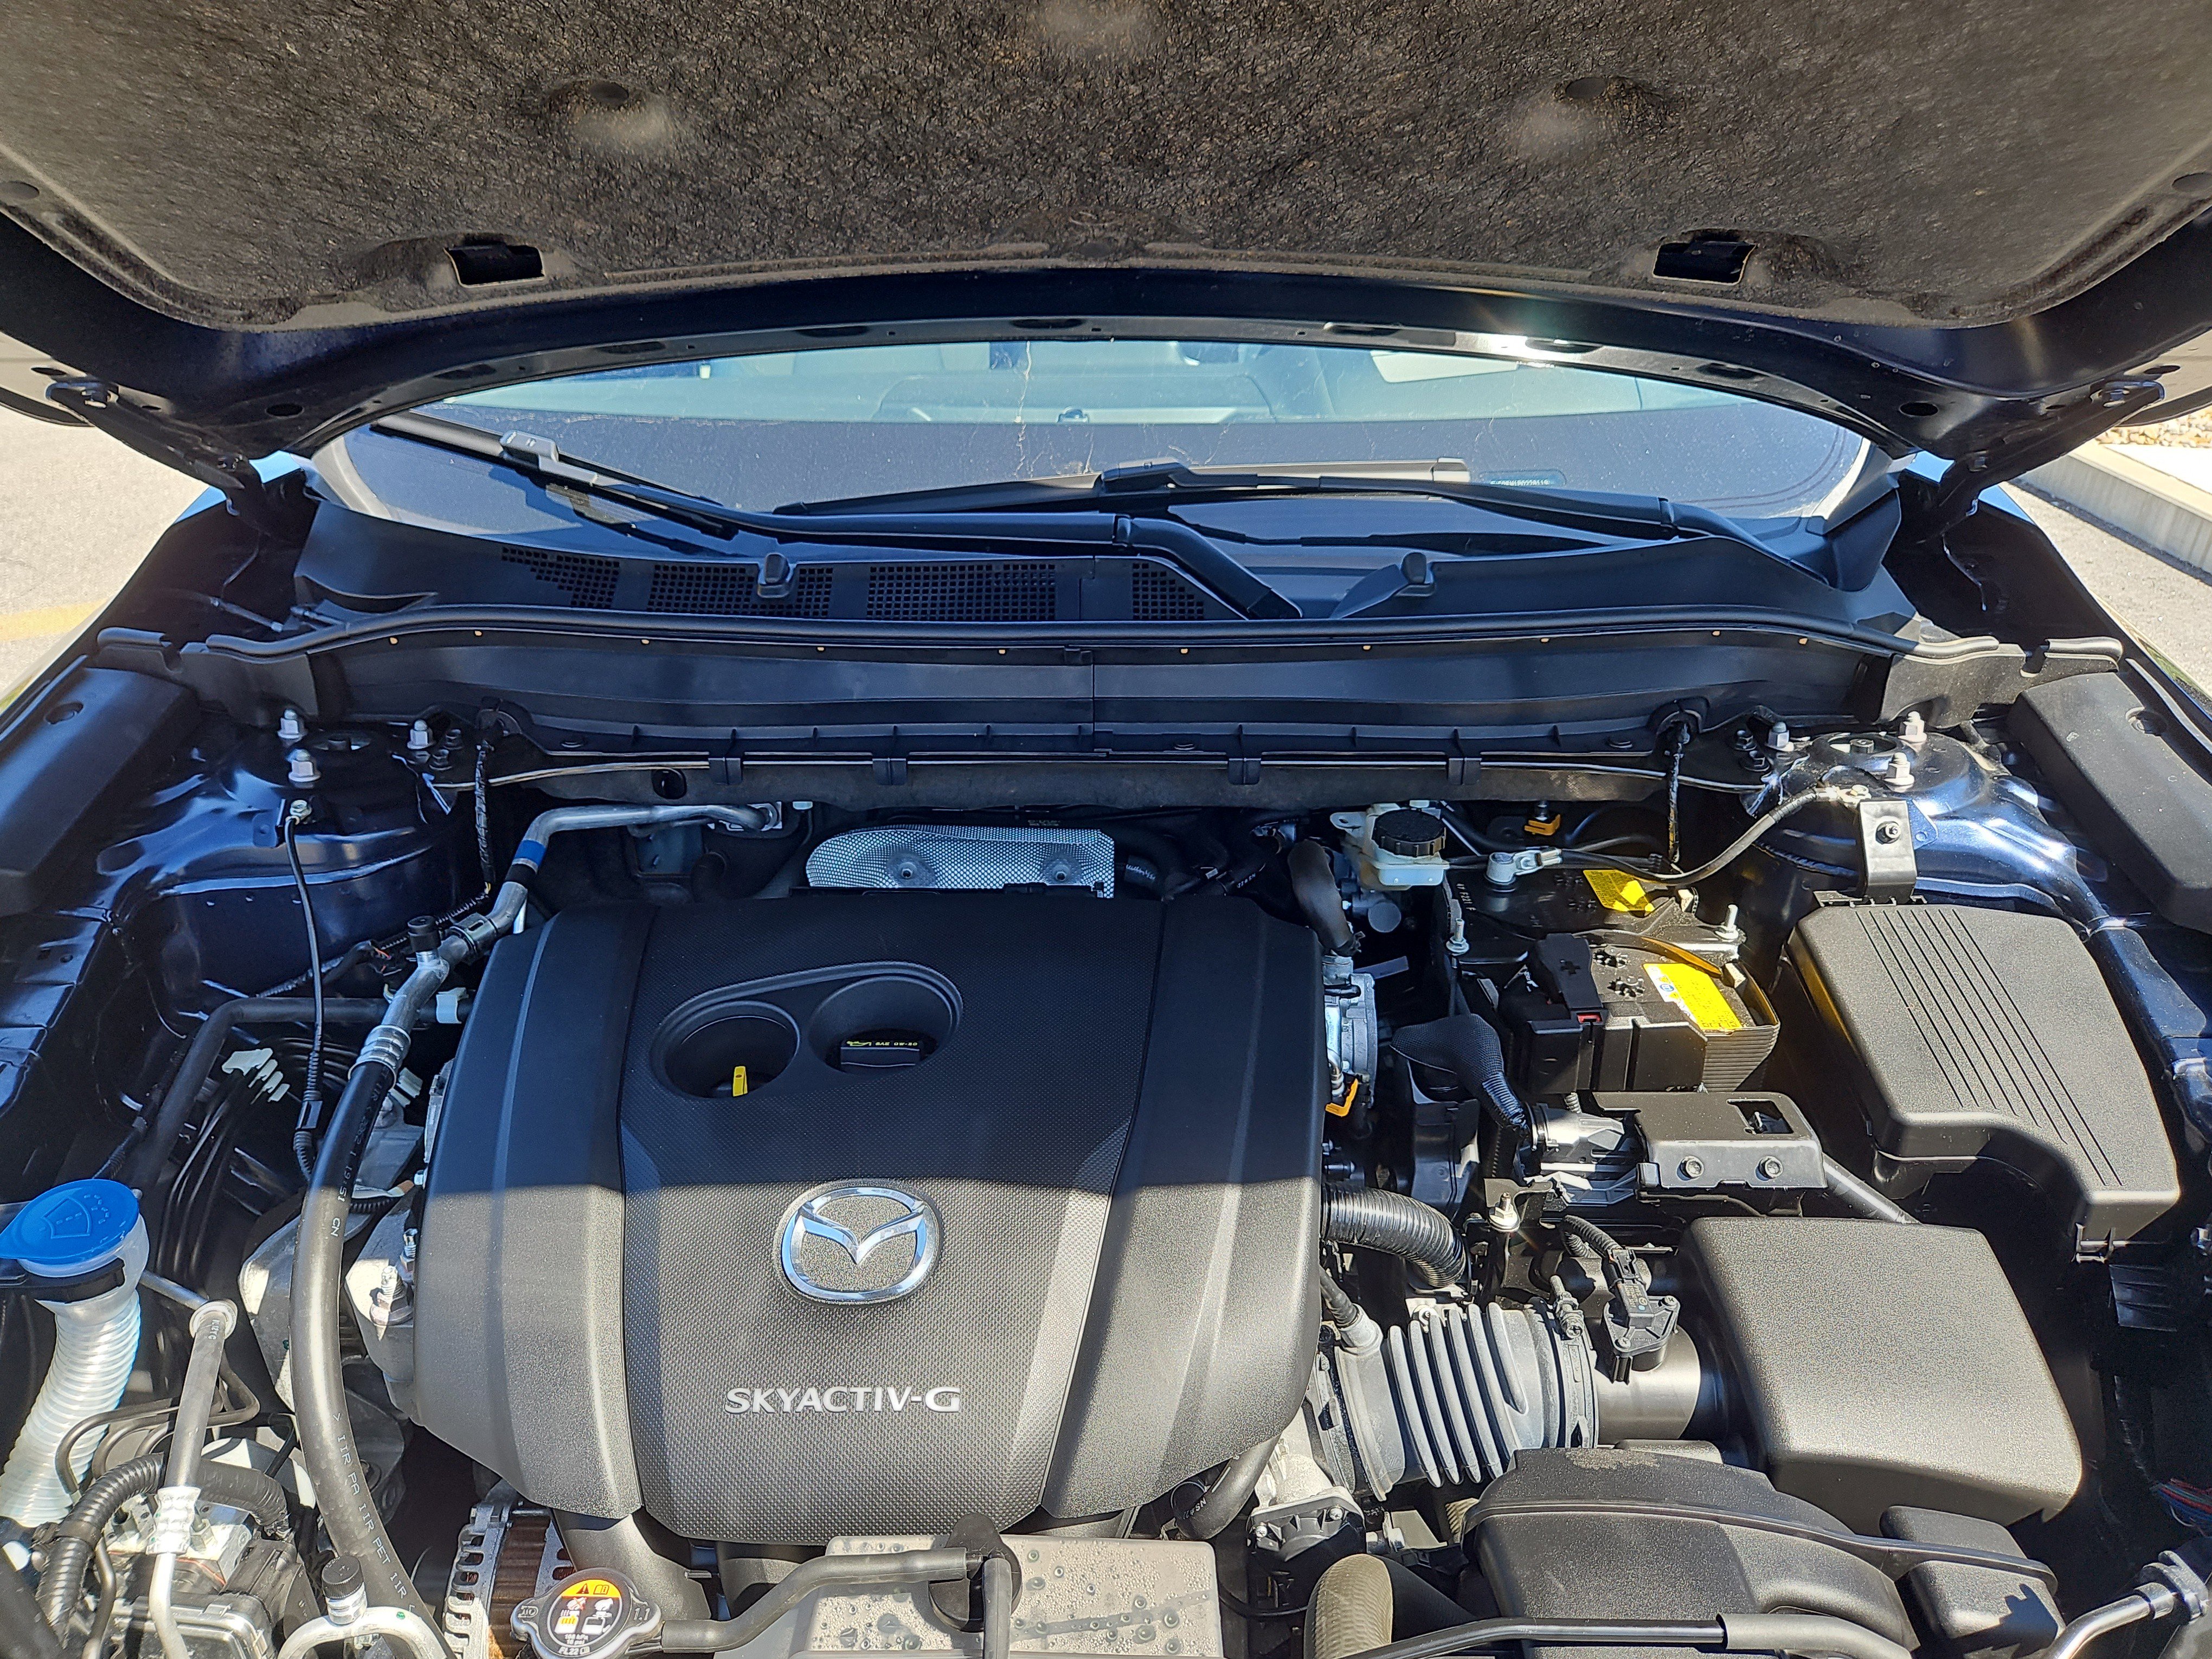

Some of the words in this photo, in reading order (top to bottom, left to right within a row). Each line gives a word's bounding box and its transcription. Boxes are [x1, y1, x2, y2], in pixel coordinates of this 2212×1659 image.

[331, 1217, 340, 1237] CN
[724, 1386, 961, 1414] SKYACTIV-G
[337, 1435, 352, 1465] IIR
[348, 1472, 361, 1496] PA
[358, 1503, 375, 1533] IIR
[372, 1536, 391, 1565] PET
[389, 1572, 407, 1599] IIR
[633, 1607, 651, 1621] 1.1
[557, 1646, 579, 1655] FL22
